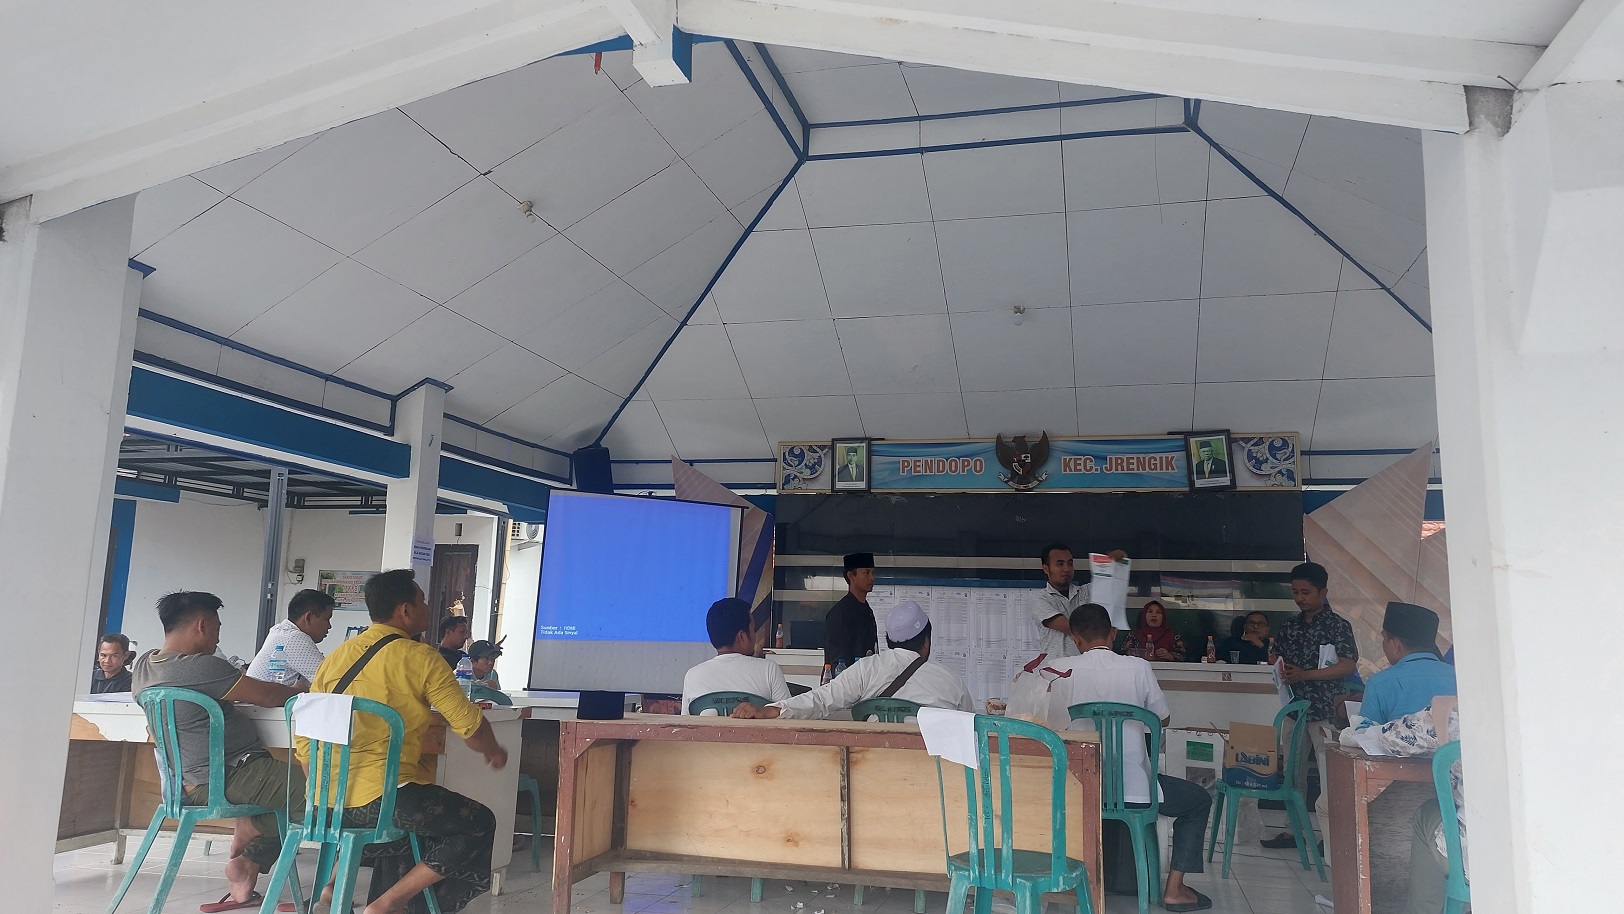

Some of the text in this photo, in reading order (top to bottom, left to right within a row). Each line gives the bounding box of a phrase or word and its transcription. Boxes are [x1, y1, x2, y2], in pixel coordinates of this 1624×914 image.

[900, 455, 1177, 475] PENDOPO KEC. JRENGIK
